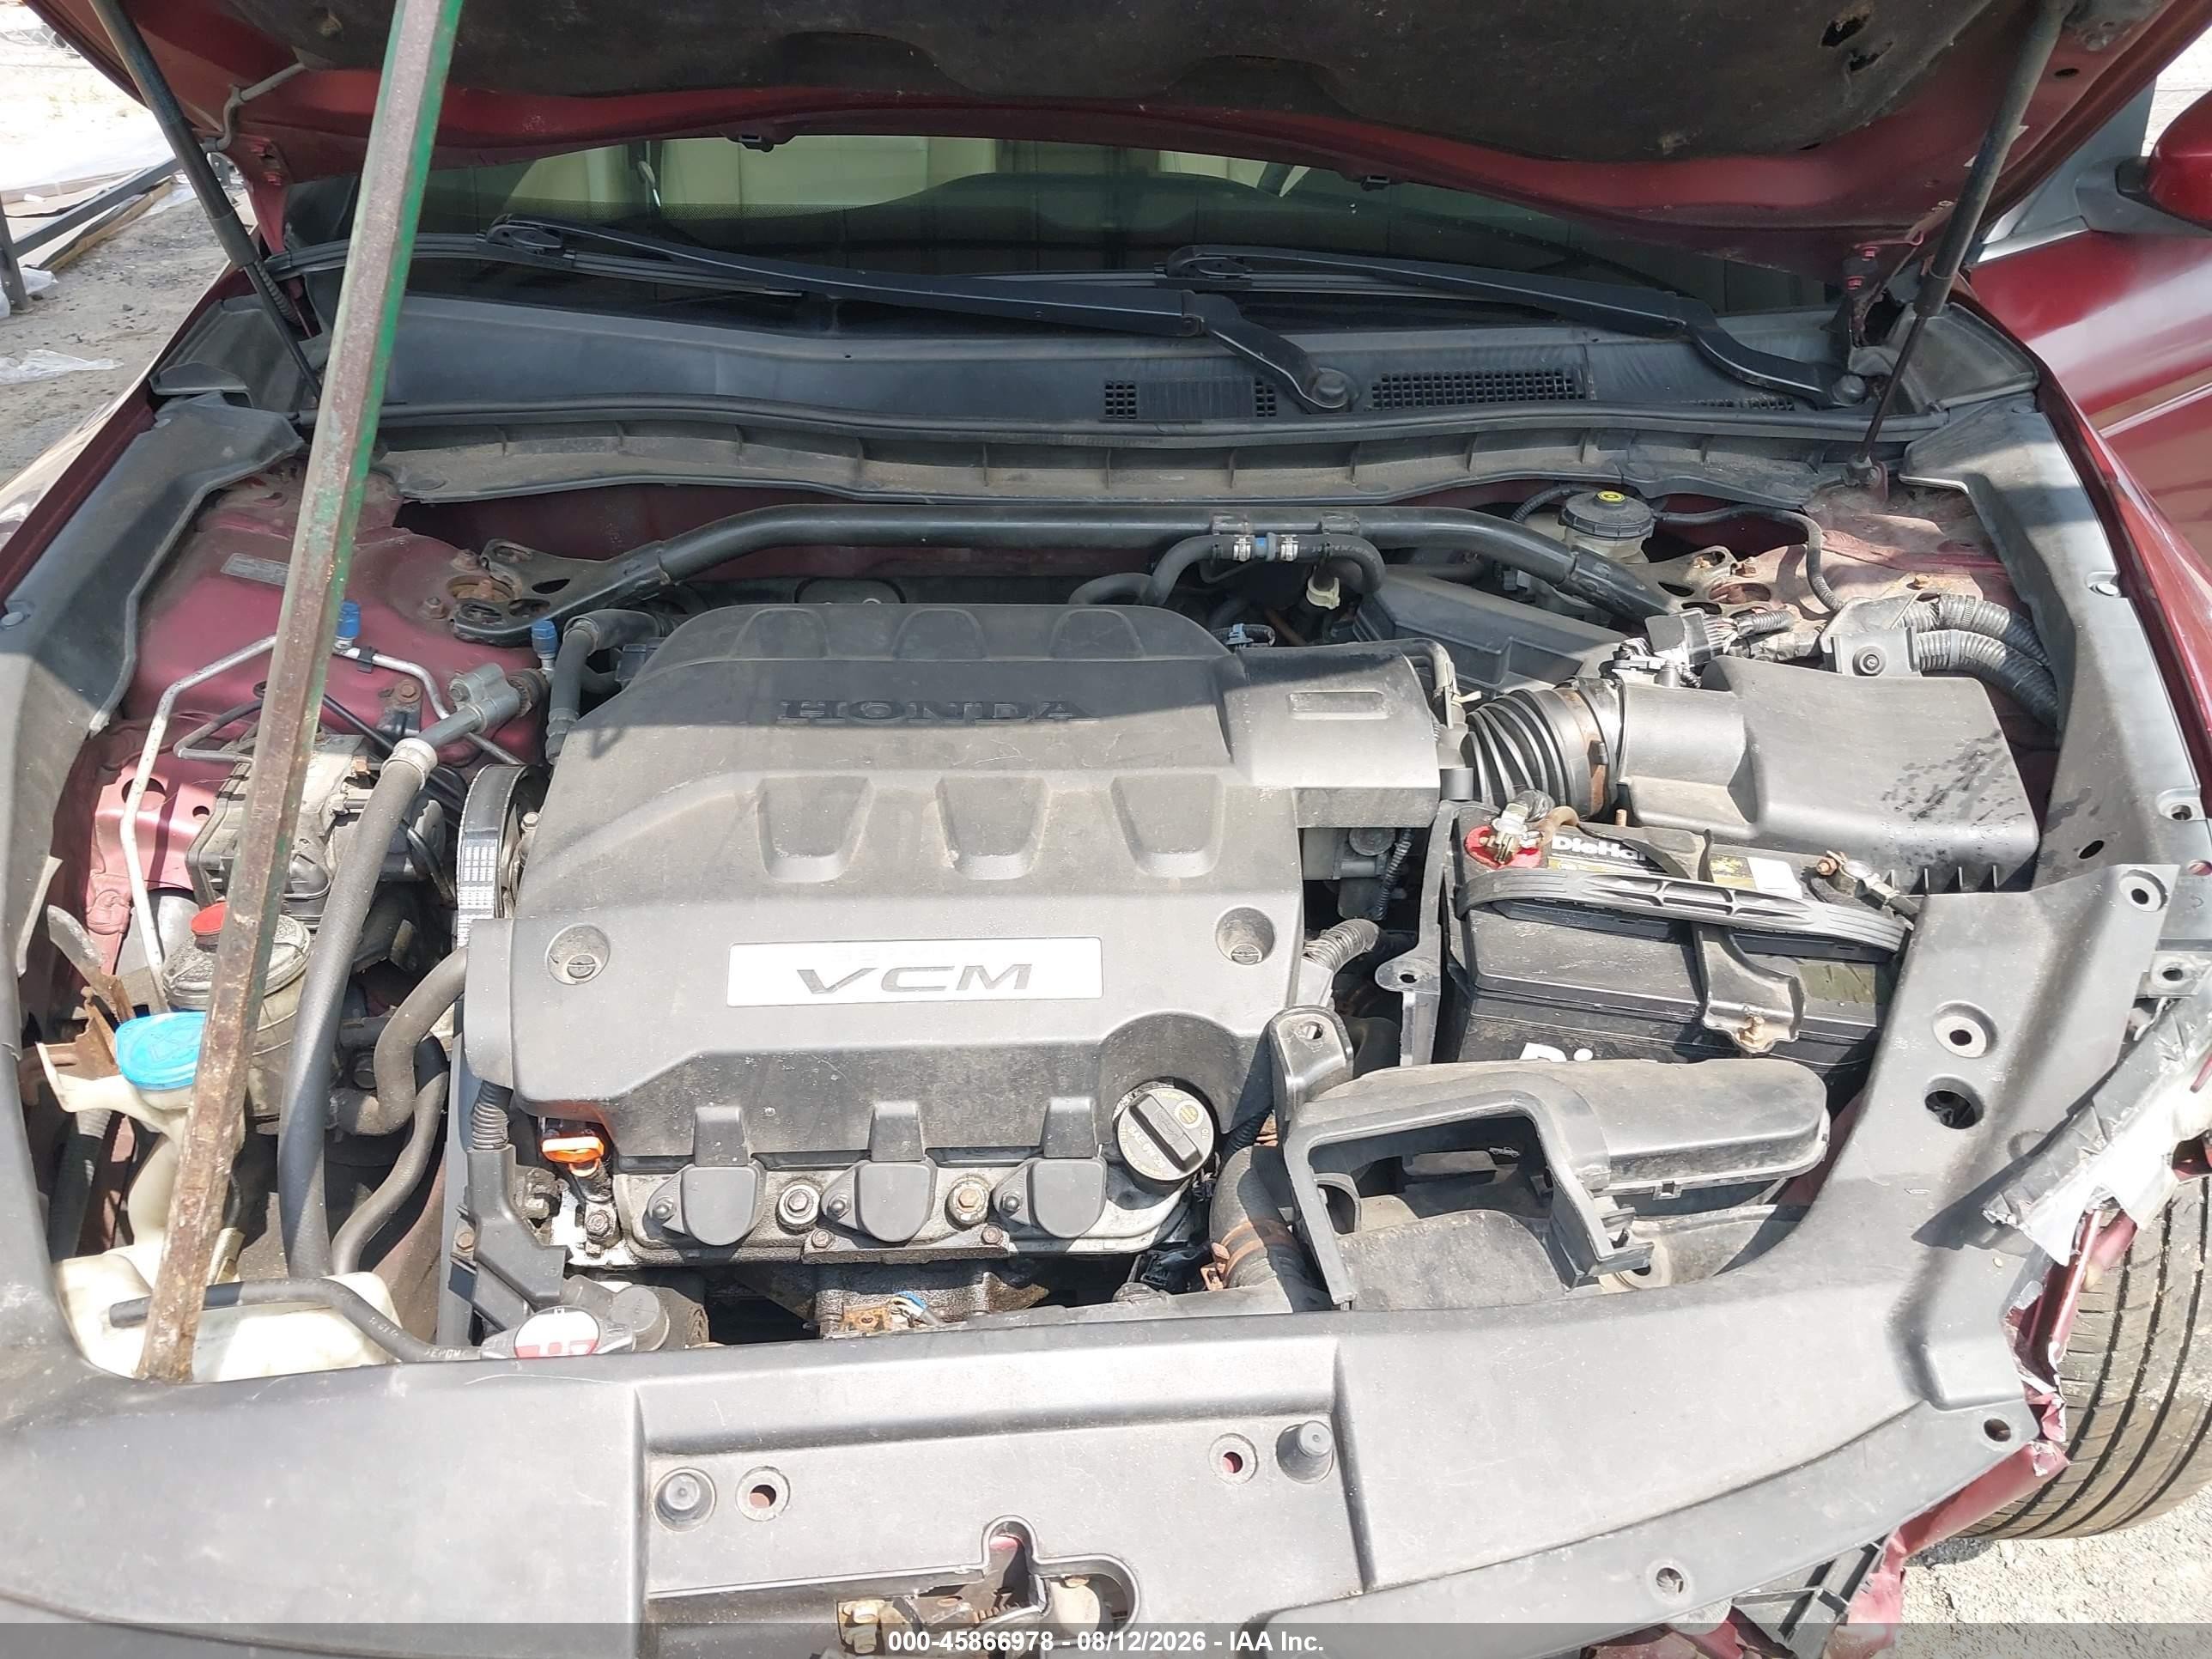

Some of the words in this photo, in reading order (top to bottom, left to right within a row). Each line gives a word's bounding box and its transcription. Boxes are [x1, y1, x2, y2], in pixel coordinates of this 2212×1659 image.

[776, 699, 1100, 724] HONDA
[1552, 836, 1646, 861] DieHar
[797, 963, 1032, 994] VCM
[1127, 1126, 1149, 1146] SAE
[1201, 1127, 1210, 1139] OIL
